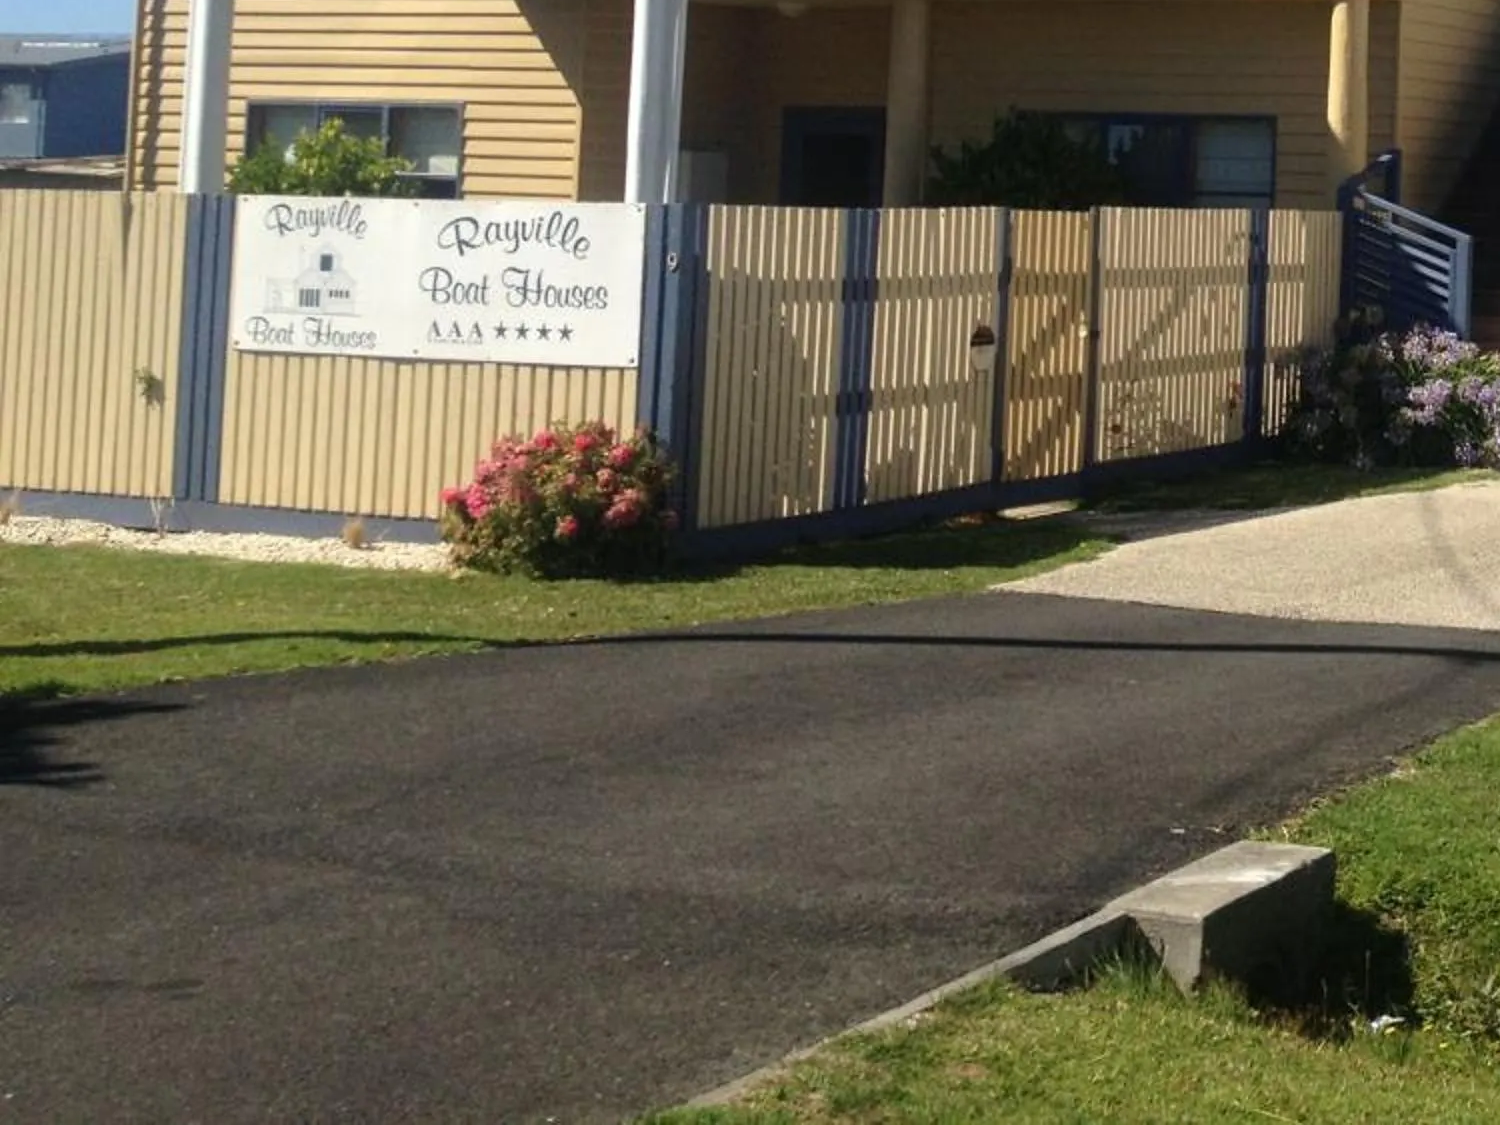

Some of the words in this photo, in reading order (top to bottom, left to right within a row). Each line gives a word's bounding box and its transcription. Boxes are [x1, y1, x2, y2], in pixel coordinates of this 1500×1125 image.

[266, 203, 368, 239] Rayville
[437, 211, 591, 260] Rayville
[418, 267, 491, 306] Boat
[502, 267, 608, 310] Houses
[245, 316, 294, 346] Boat
[301, 317, 377, 350] Houses
